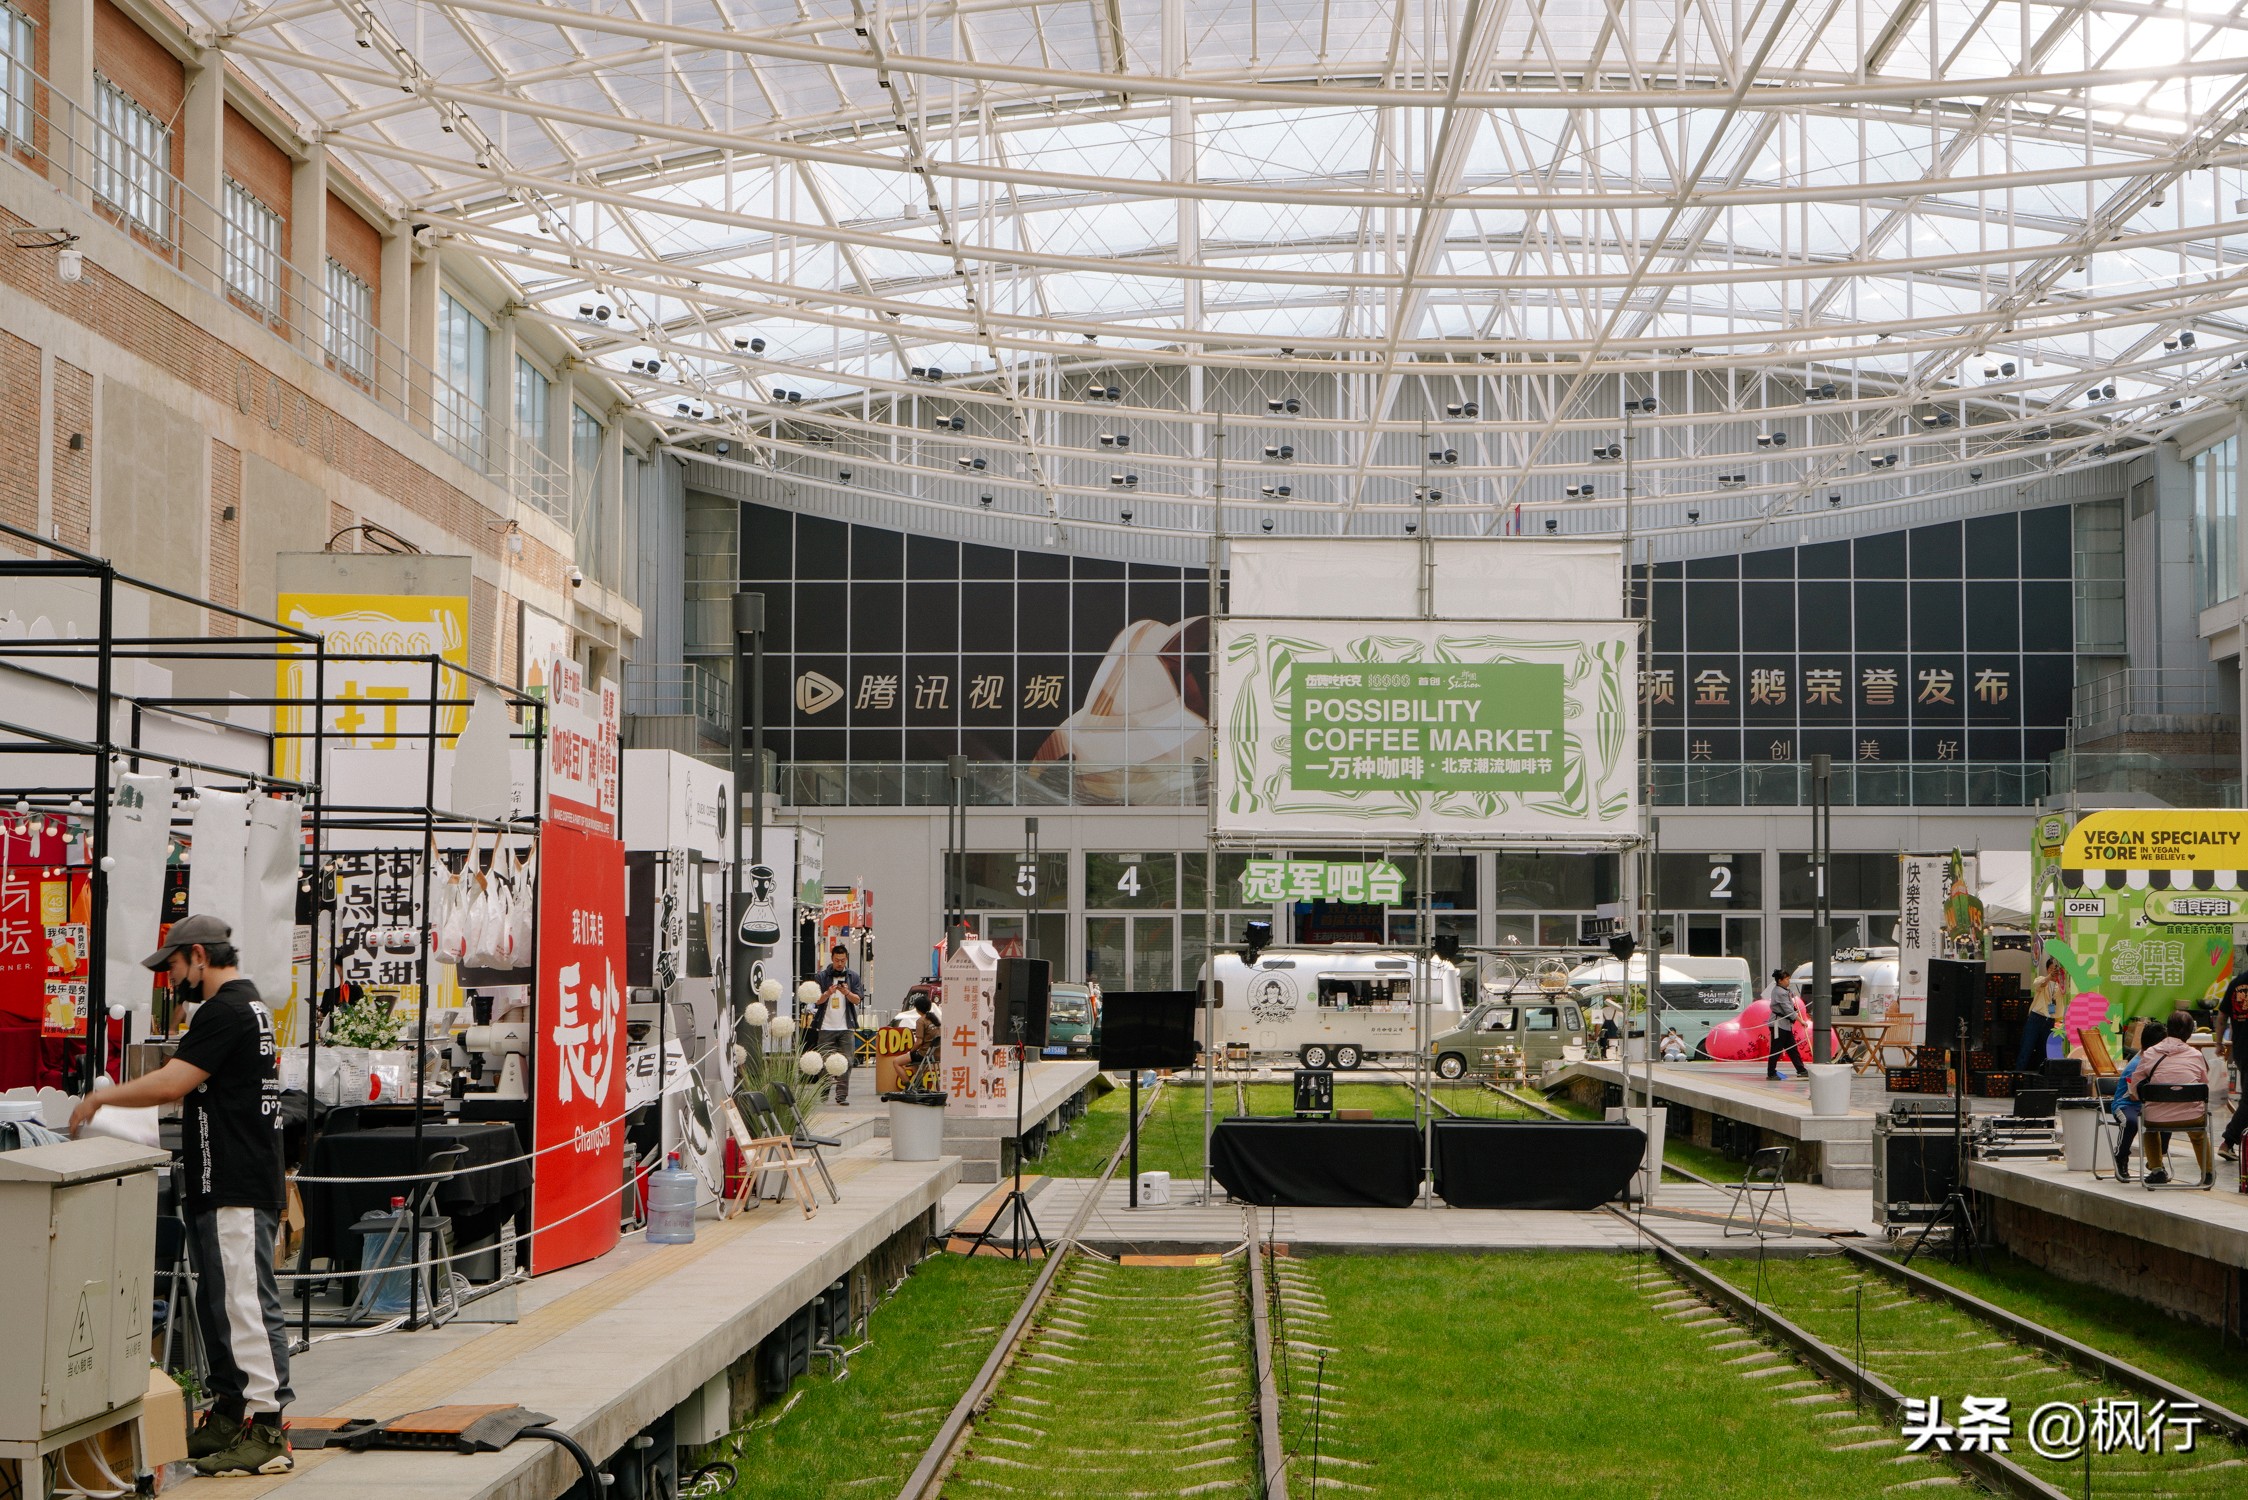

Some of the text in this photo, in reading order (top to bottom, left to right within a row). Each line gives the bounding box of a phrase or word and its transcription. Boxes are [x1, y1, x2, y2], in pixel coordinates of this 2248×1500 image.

[855, 675, 1065, 709] 腾讯视频
[1305, 699, 1482, 722] POSSIBILITY
[1304, 728, 1552, 751] COFFEE MARKET
[1305, 756, 1424, 780] 一万种咖啡
[1441, 757, 1553, 774] 北京潮流咖啡节
[2084, 830, 2241, 845] VEGAN SPECIALTY
[2084, 846, 2137, 860] STORE
[1016, 865, 1036, 897] 5
[1117, 865, 1141, 897] 4
[1247, 862, 1403, 902] 冠军吧台
[1710, 866, 1732, 897] 2
[824, 902, 860, 913] PINEAPPLE
[1906, 862, 1921, 949] 快樂起飛
[2069, 903, 2099, 912] OPEN
[2173, 898, 2231, 915] 蔬食宇宙
[48, 927, 76, 938] 我偷了
[572, 908, 604, 947] 我们来自
[2167, 924, 2233, 935] 蔬食生活方式集合
[879, 1028, 913, 1055] IDA
[951, 1025, 977, 1098] 牛乳
[67, 1355, 92, 1378] 当心触电
